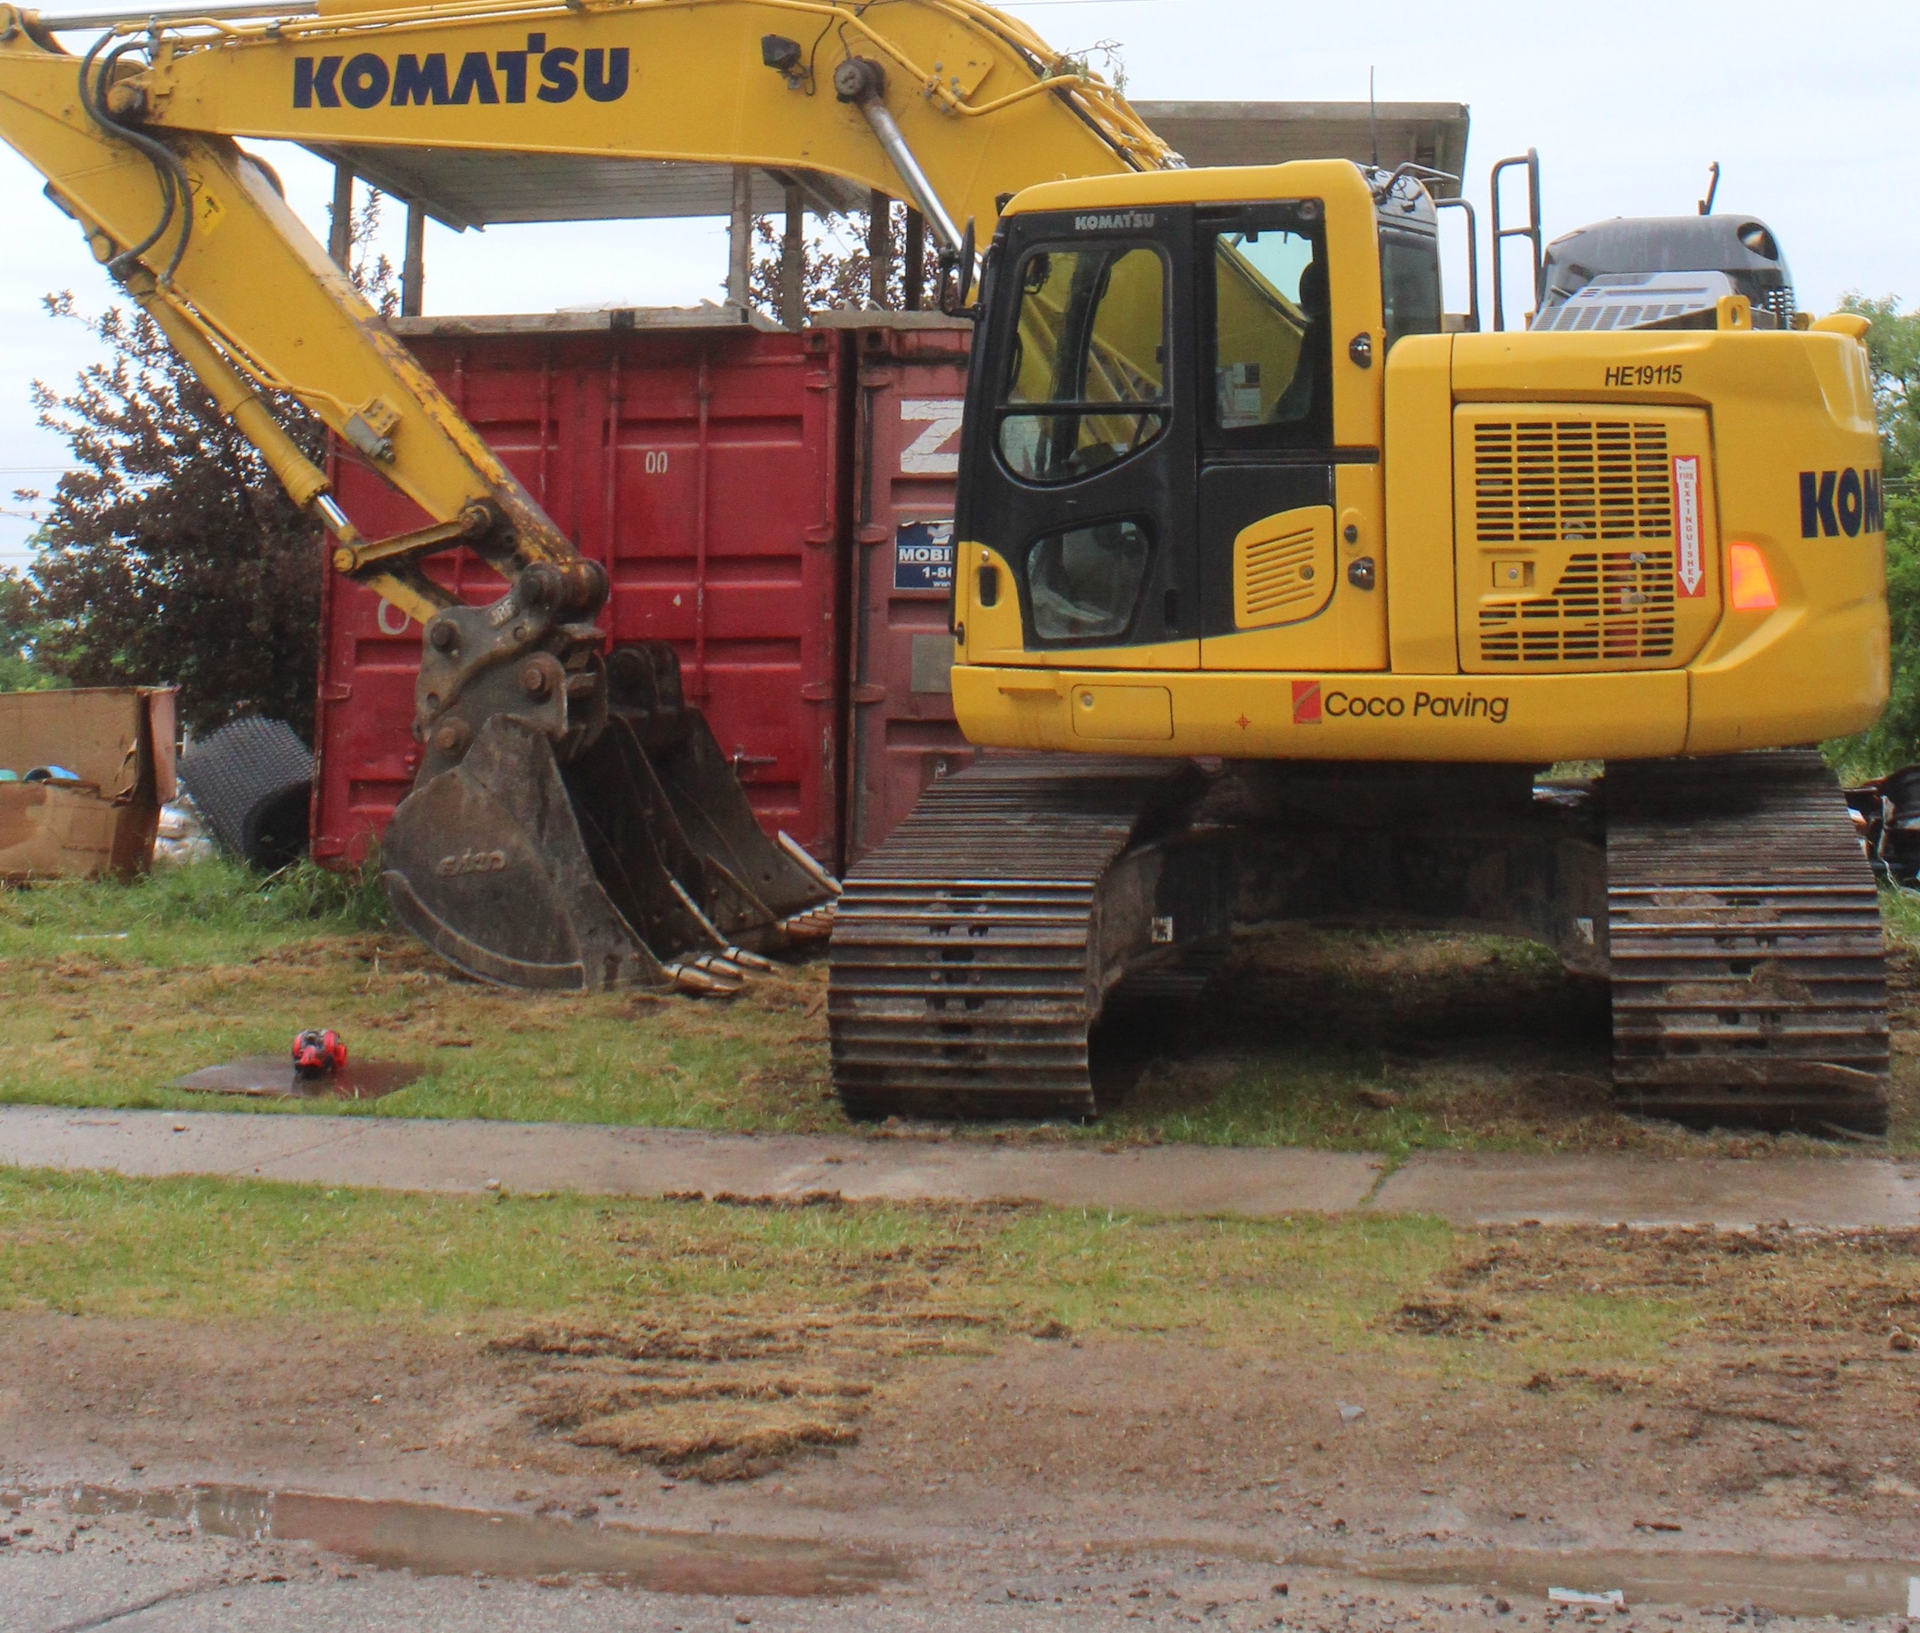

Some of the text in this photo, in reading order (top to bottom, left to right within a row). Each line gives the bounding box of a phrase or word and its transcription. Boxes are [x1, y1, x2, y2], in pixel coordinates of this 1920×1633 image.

[293, 33, 630, 109] KOMATSU
[1075, 210, 1155, 230] KOMATSU
[1605, 364, 1682, 386] HE19115
[1679, 472, 1694, 480] FIRE
[1684, 481, 1695, 585] EXTINGUISHER
[899, 548, 953, 561] MOBI
[1324, 691, 1510, 724] Coco Paving
